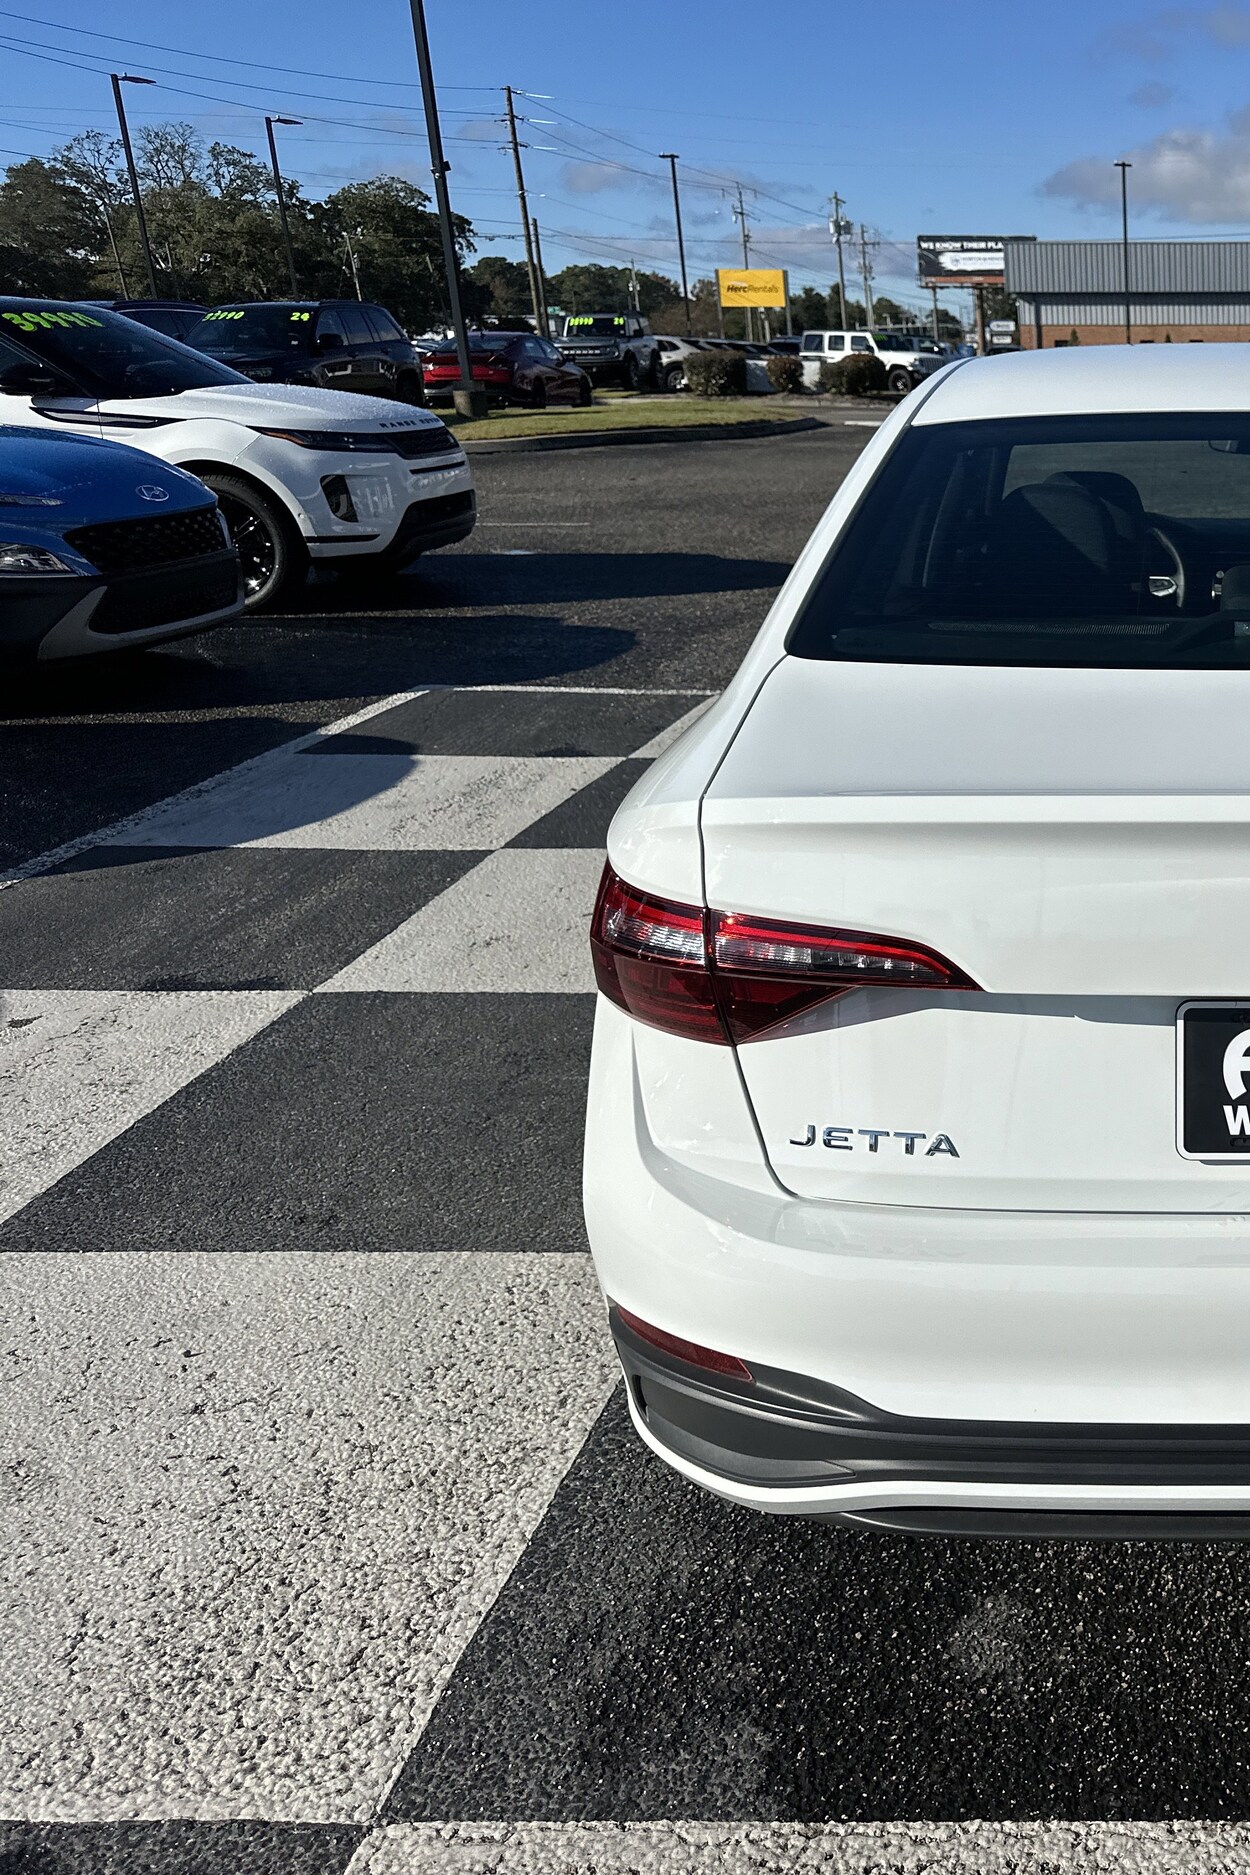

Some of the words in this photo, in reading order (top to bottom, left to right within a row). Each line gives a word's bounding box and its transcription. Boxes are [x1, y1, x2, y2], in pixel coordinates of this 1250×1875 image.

[920, 241, 934, 249] WE
[935, 241, 961, 250] KNOW
[963, 241, 986, 249] THEIR
[290, 312, 310, 321] 24
[2, 312, 105, 331] 39990
[379, 420, 417, 428] RANGE
[789, 1124, 960, 1159] JETTA
